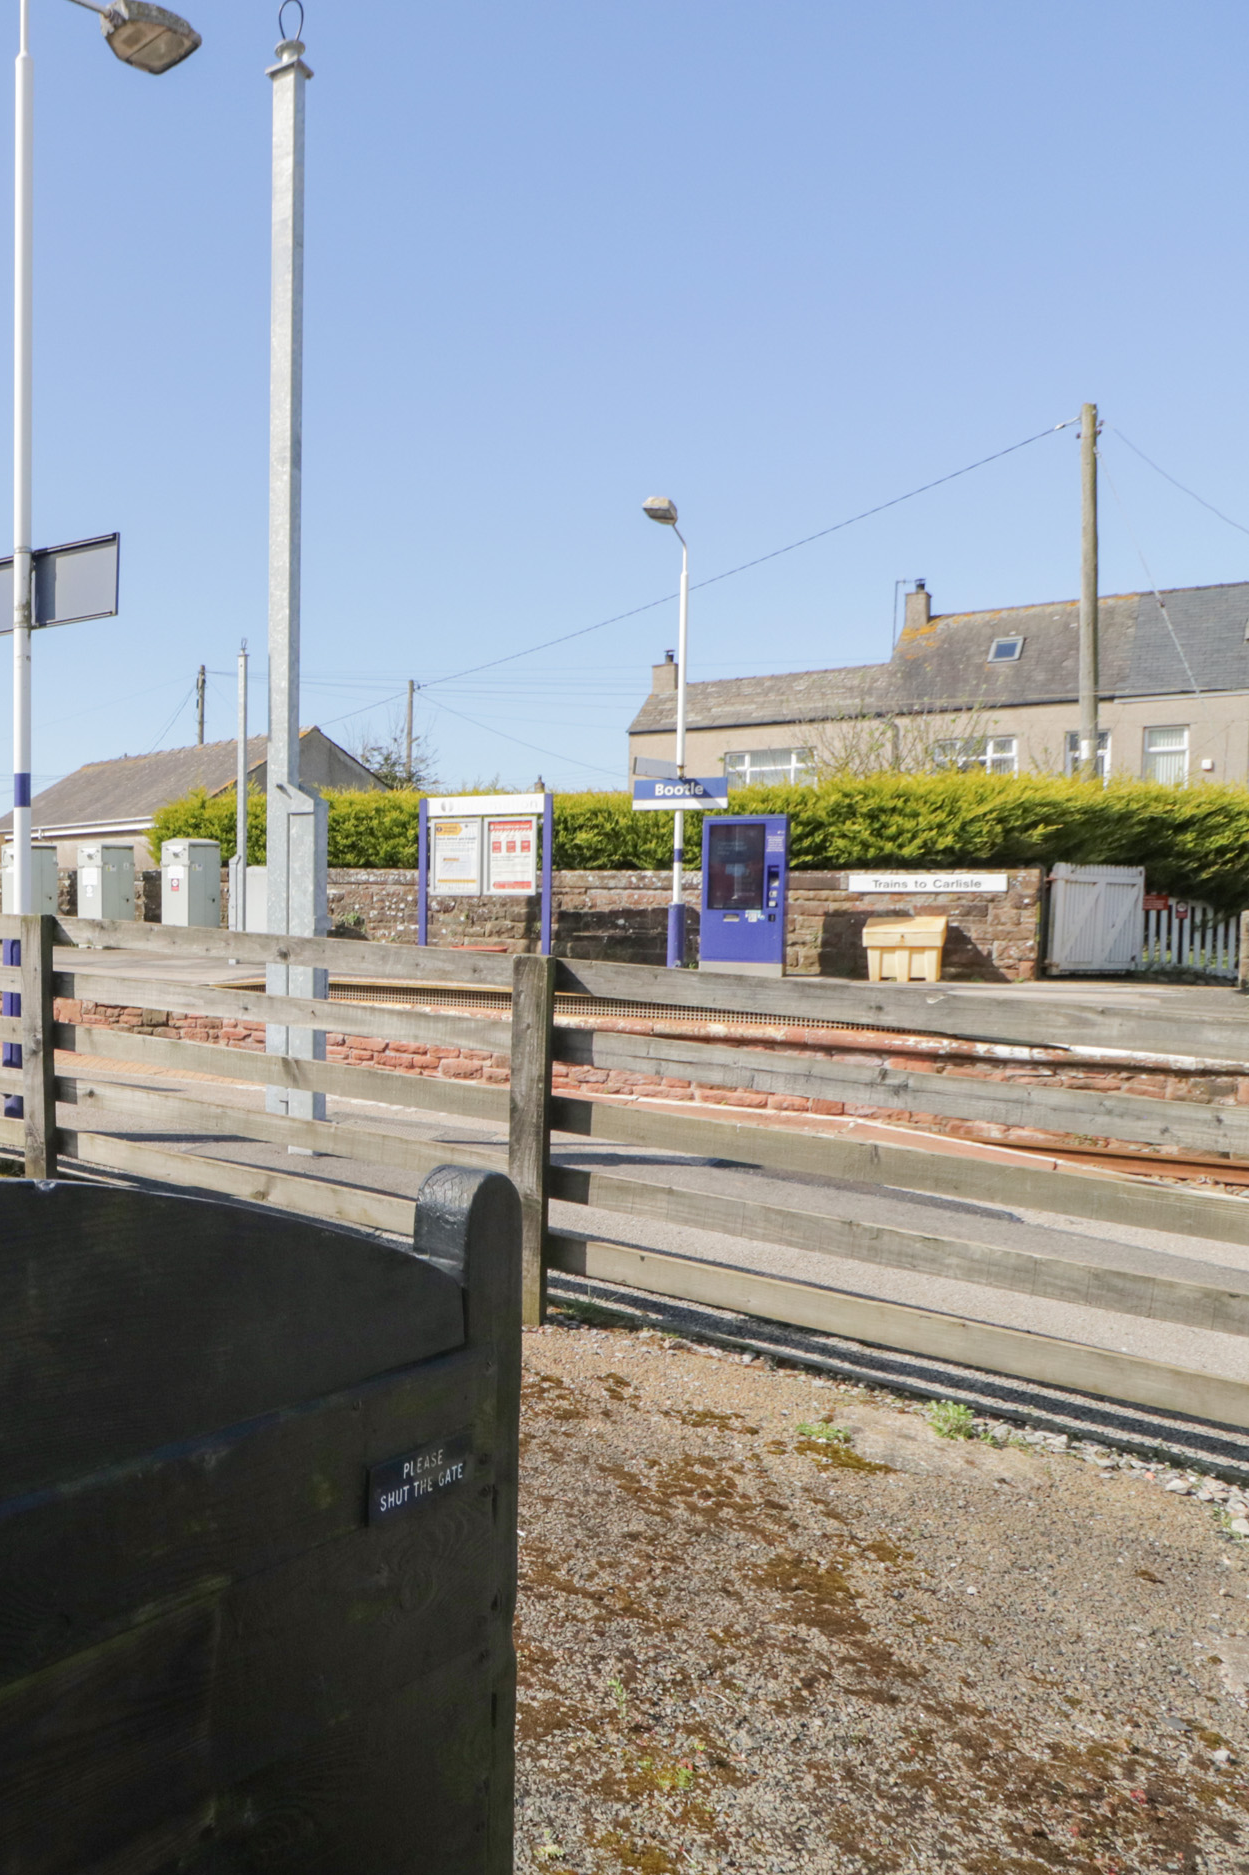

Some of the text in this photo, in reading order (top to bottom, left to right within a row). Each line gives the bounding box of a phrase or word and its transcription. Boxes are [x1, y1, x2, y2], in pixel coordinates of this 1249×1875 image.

[654, 782, 704, 797] Bootle
[872, 878, 982, 889] Trains to Carlisle
[403, 1449, 444, 1479] PLEASE
[380, 1463, 463, 1512] SHUT THE GATE
